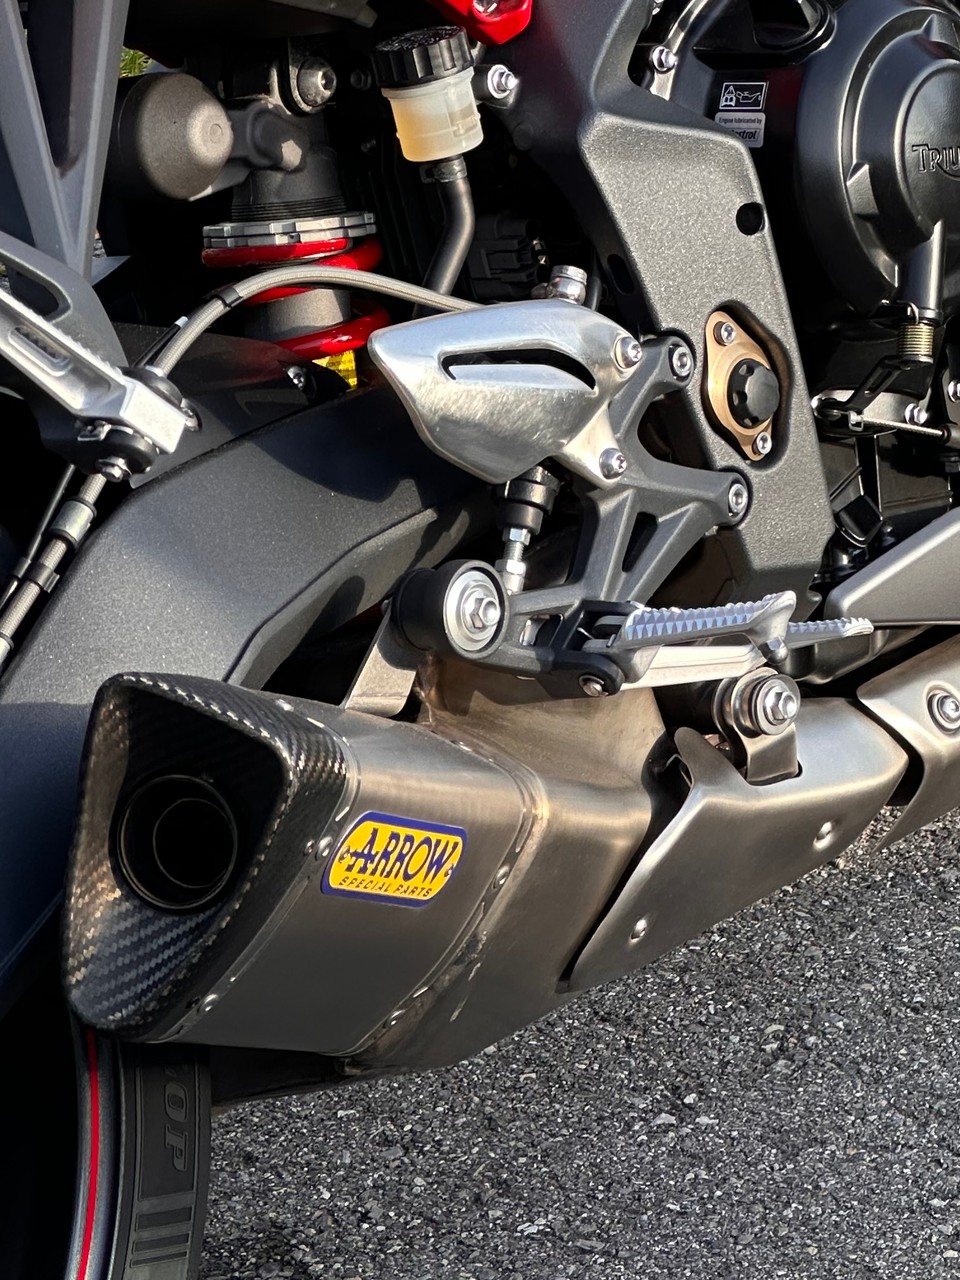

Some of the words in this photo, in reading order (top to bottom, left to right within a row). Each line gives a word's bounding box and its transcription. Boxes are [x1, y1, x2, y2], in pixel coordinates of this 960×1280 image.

[345, 827, 459, 884] ARROW
[338, 876, 392, 893] SPECIAL
[393, 884, 432, 898] PARTS
